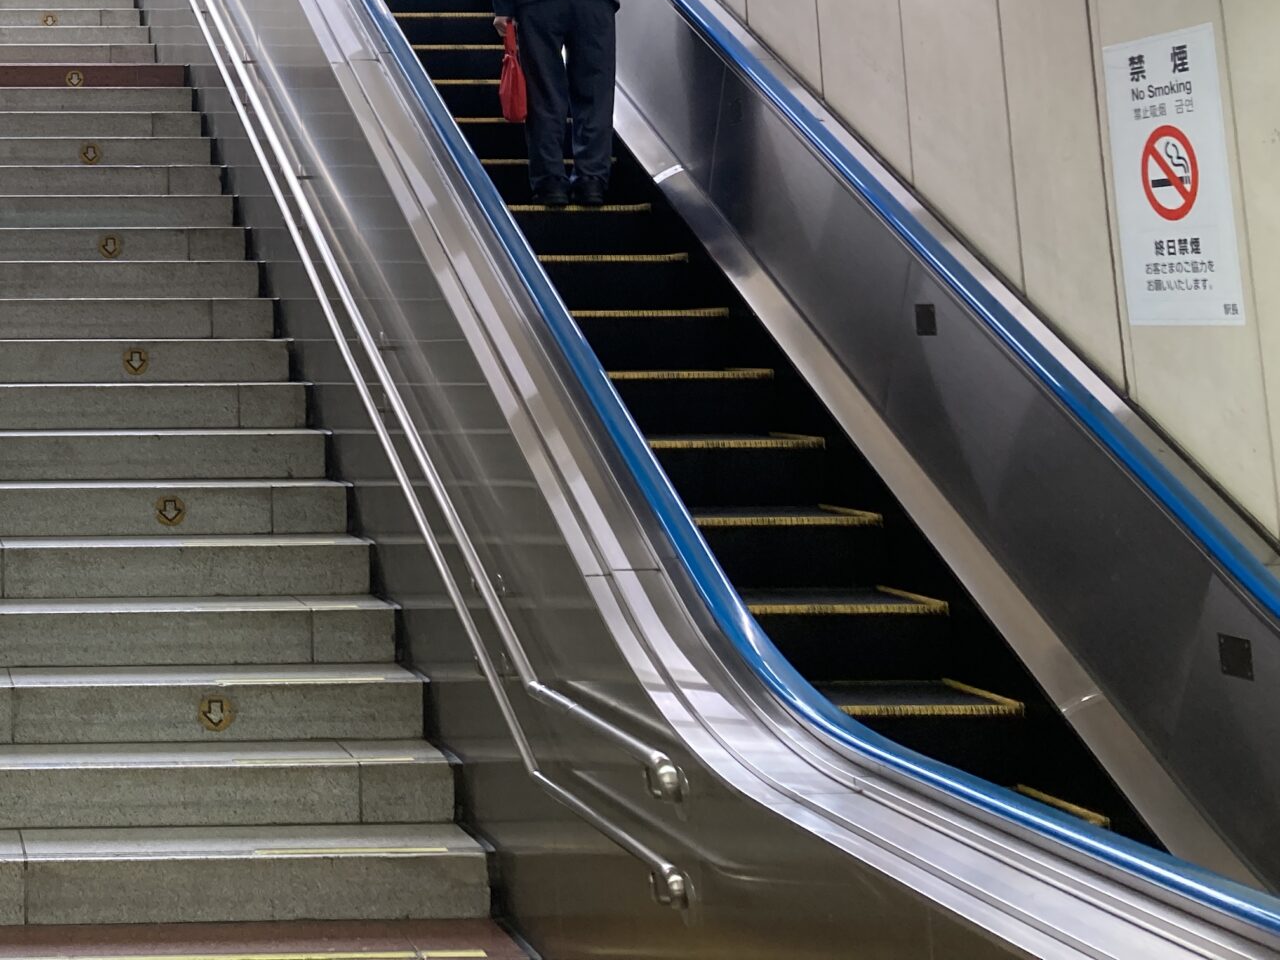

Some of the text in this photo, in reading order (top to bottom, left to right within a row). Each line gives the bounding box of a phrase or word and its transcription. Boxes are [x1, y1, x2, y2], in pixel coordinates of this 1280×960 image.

[1128, 44, 1189, 83] 禁煙
[1131, 79, 1193, 101] No Smoking
